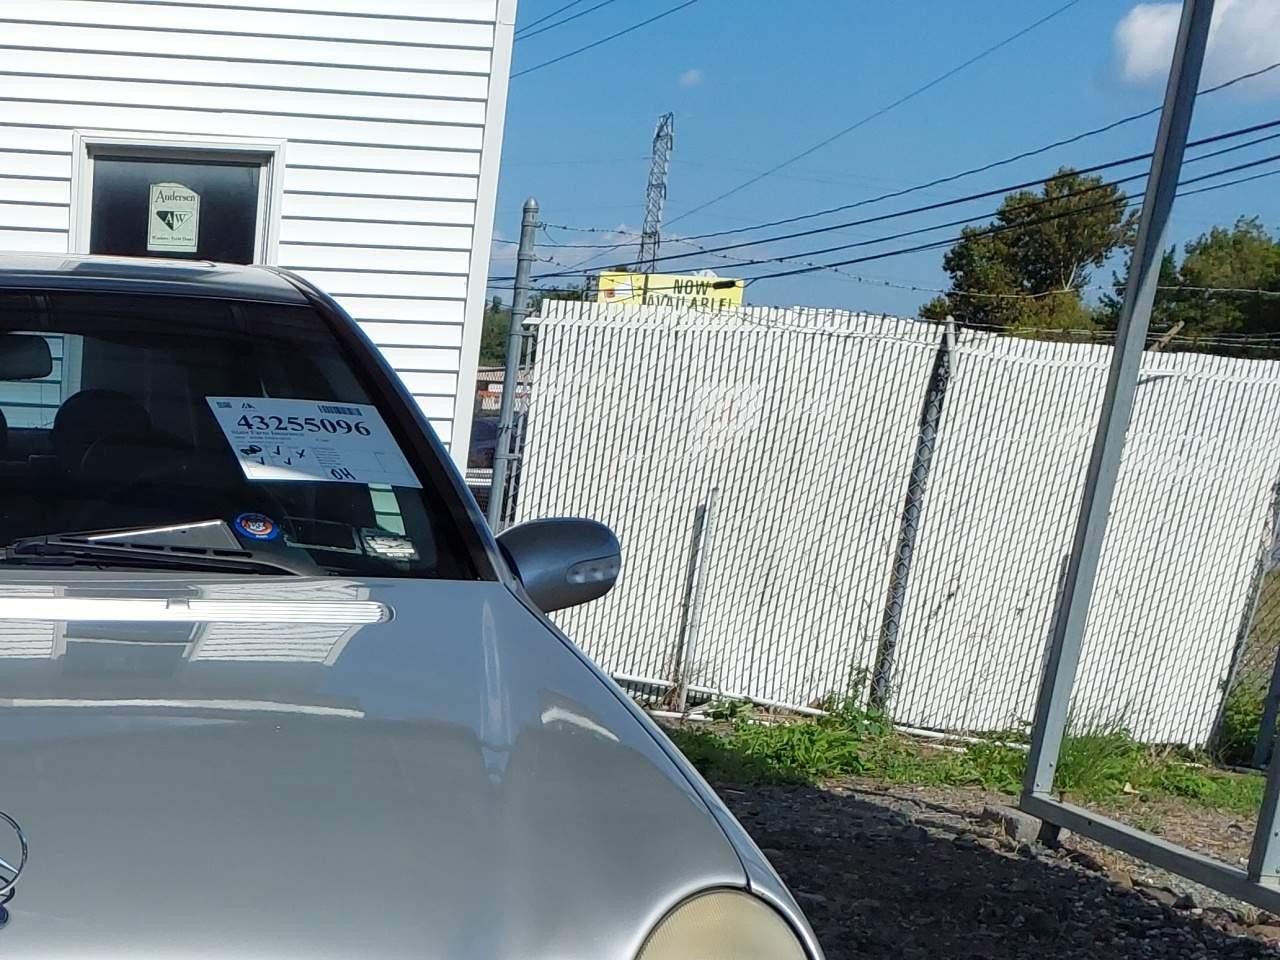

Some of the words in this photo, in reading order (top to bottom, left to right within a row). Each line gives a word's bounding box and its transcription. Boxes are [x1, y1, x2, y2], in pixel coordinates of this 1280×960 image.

[154, 190, 196, 203] Andersen
[164, 211, 188, 224] AW
[673, 279, 711, 296] NOW
[236, 414, 371, 437] 43255096
